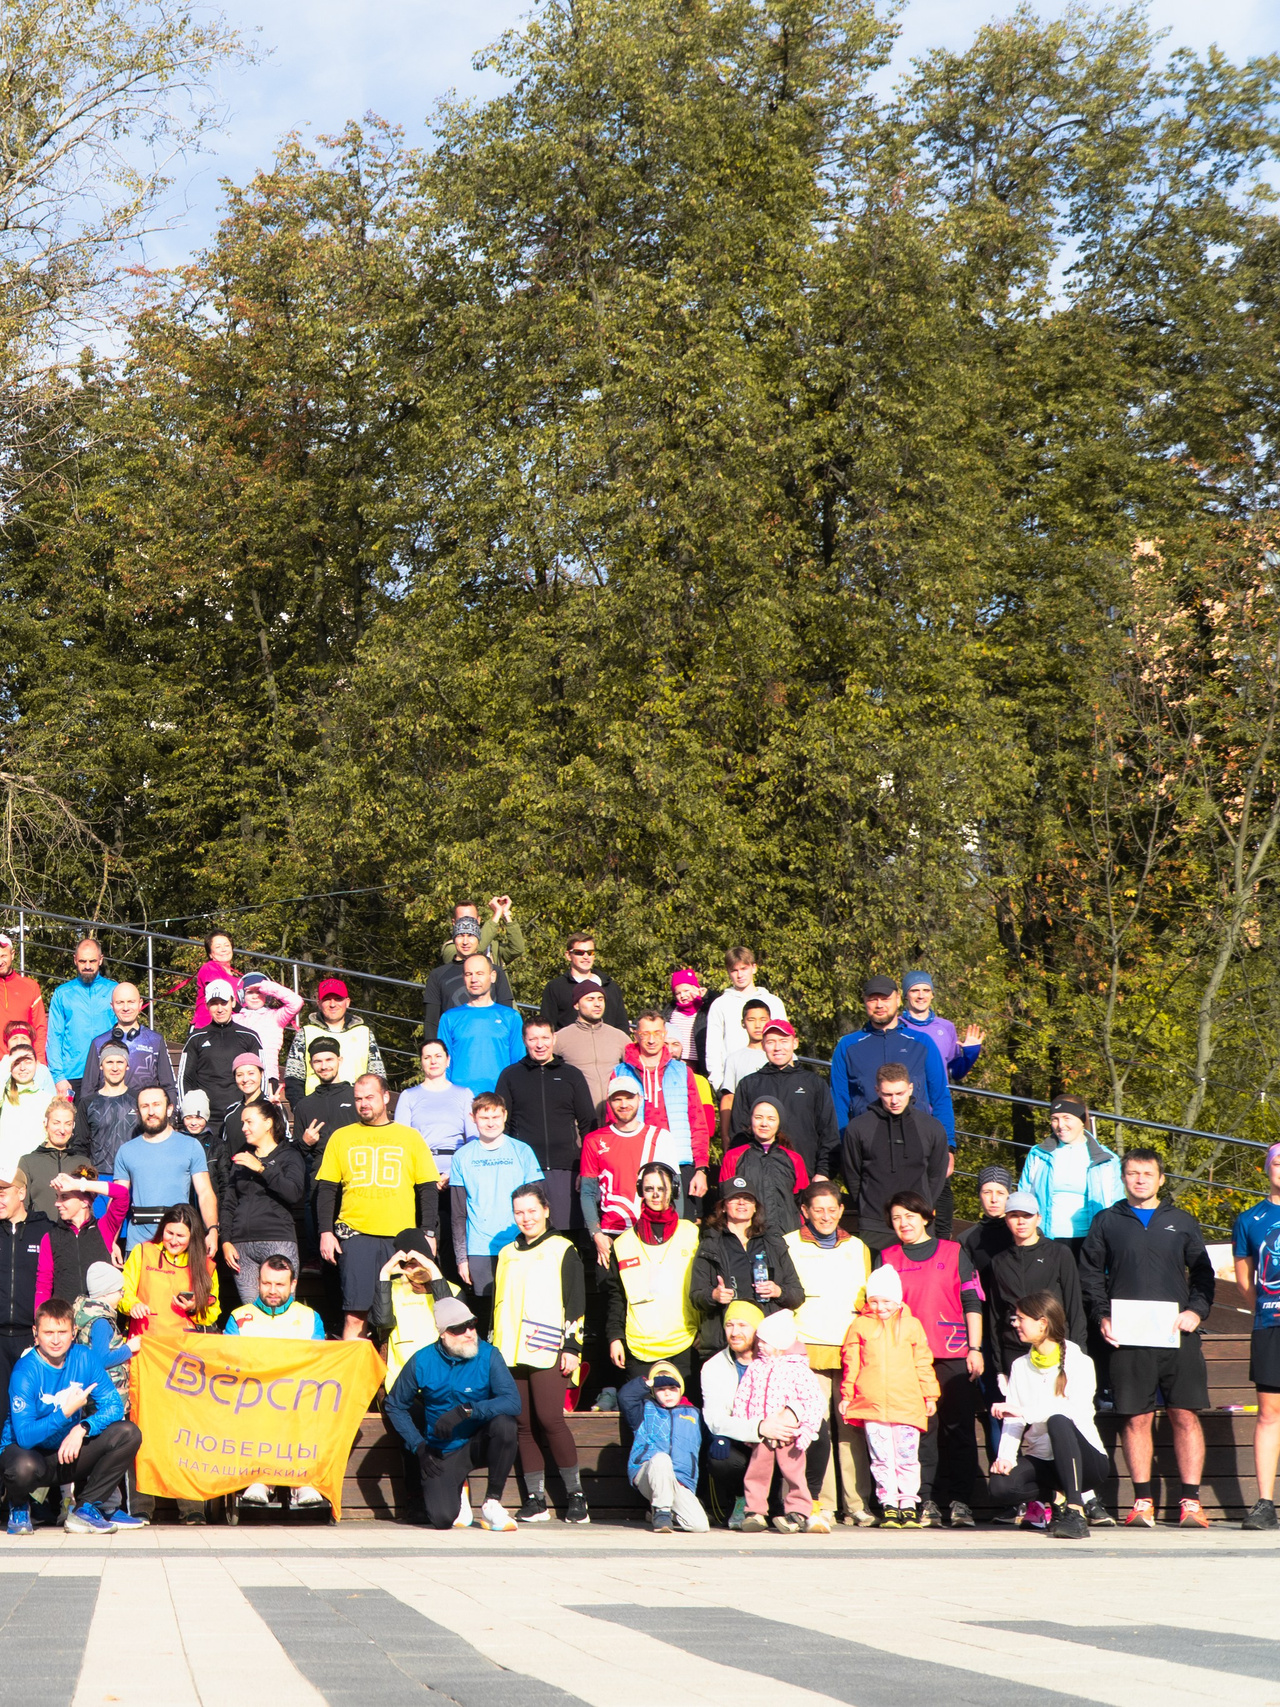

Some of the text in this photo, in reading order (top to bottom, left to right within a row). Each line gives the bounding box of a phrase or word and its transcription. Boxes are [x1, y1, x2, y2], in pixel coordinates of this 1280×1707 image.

[348, 1145, 403, 1188] 96
[174, 1428, 318, 1462] ЛЮБЕРЦЫ
[178, 1457, 308, 1478] НАТАШИНСКИЙ
